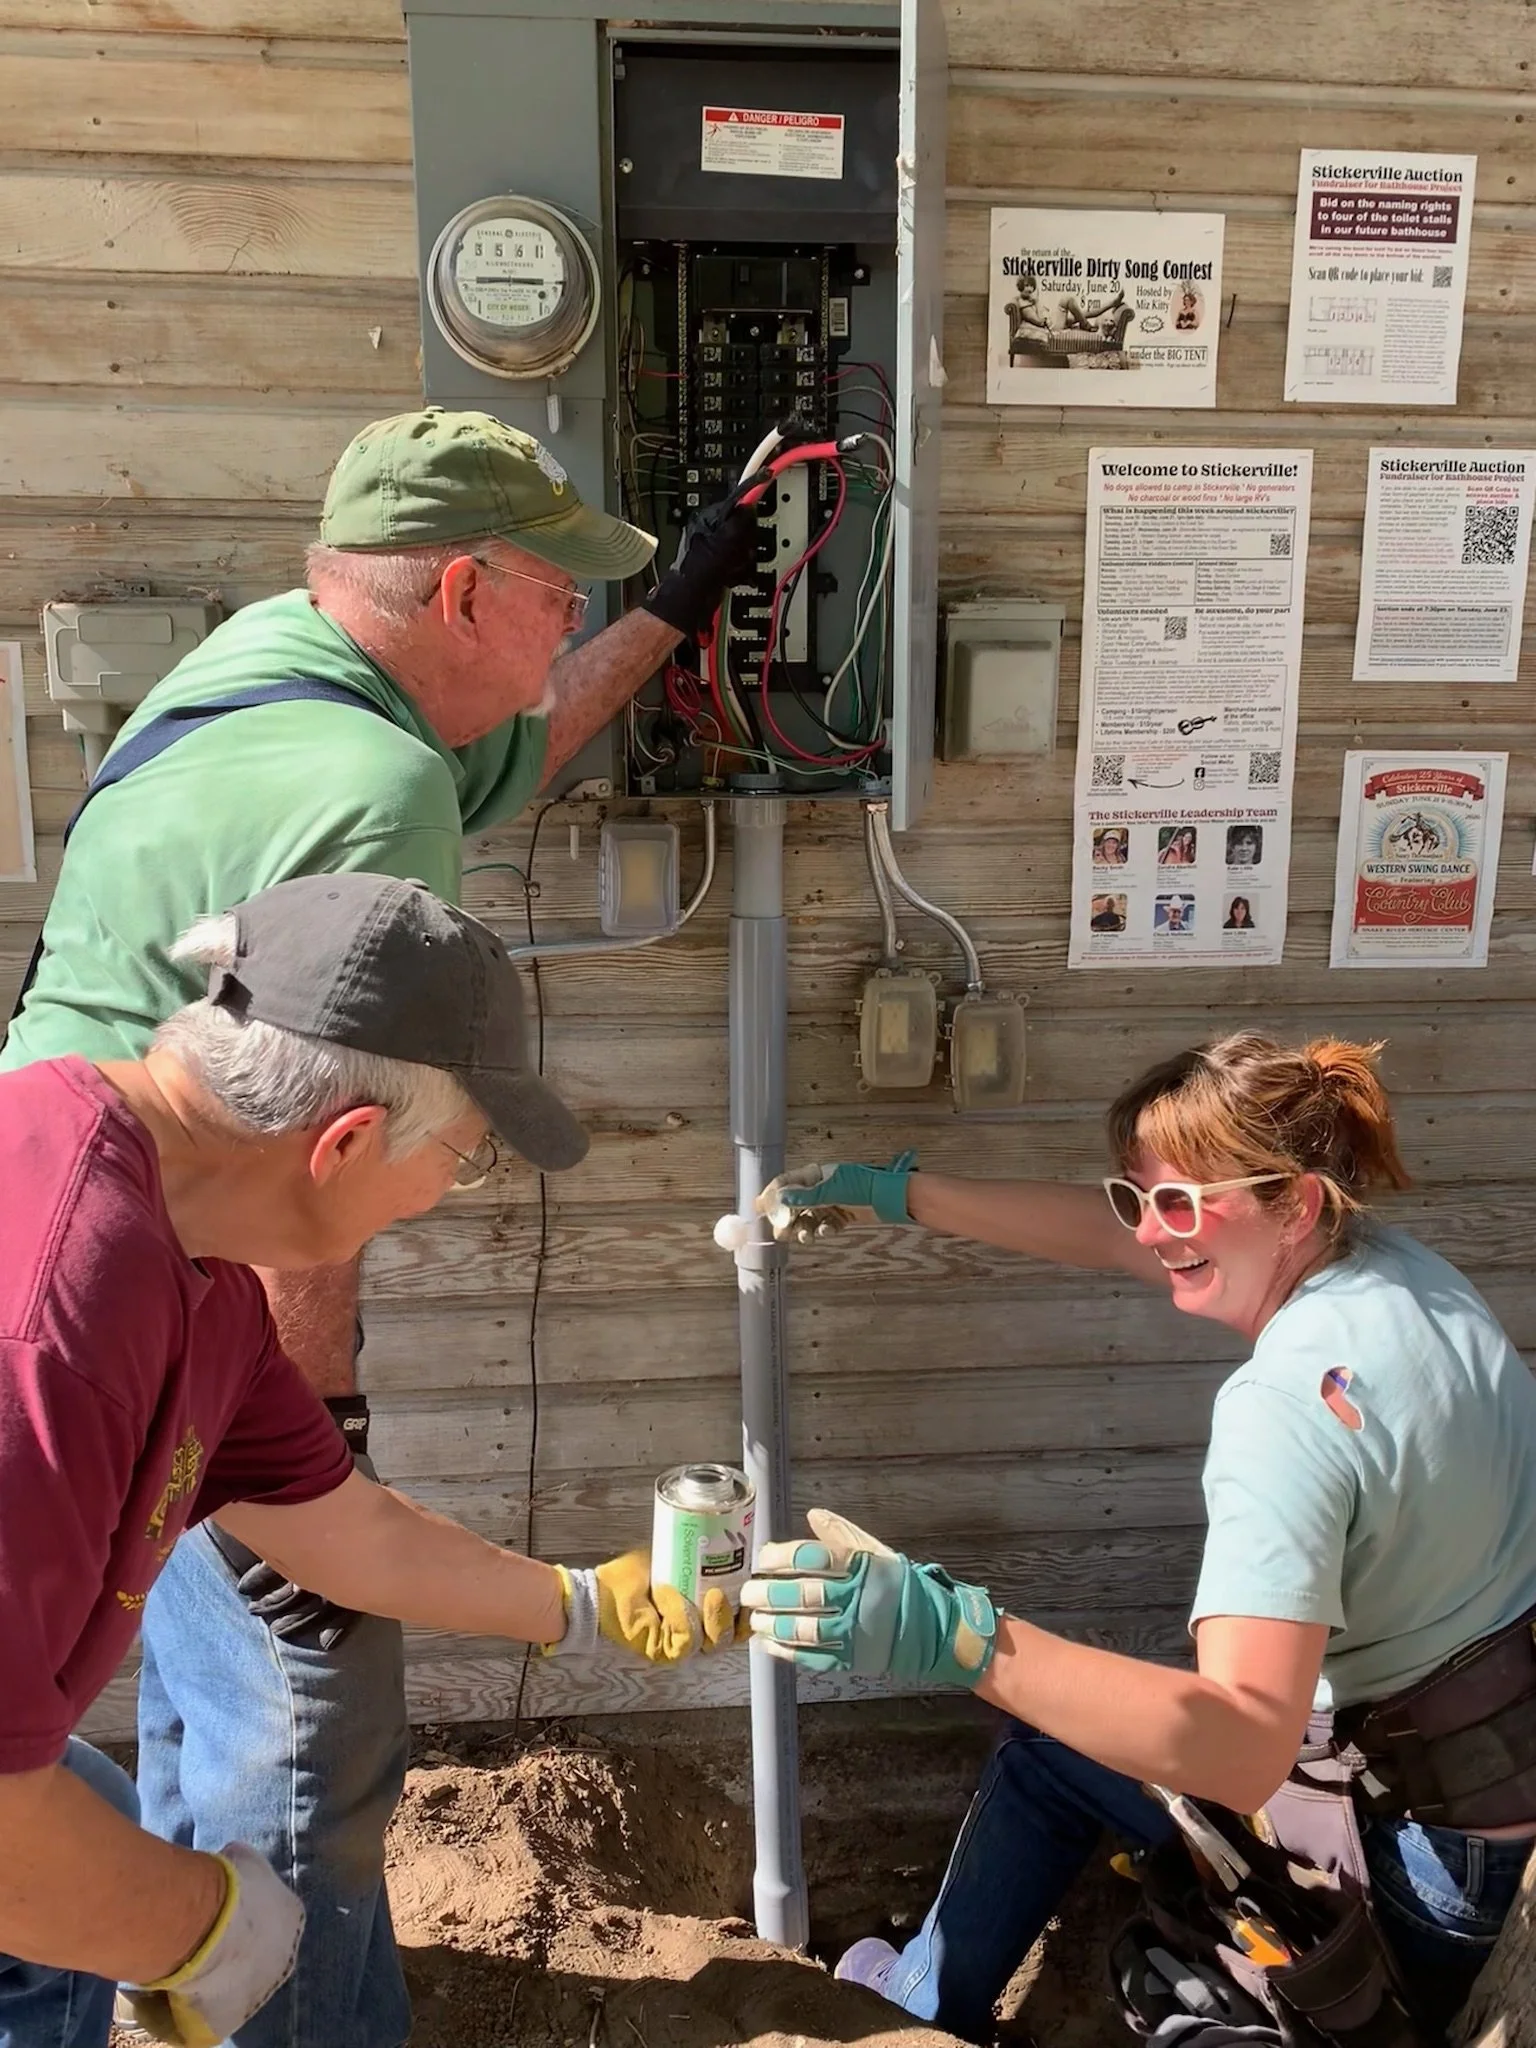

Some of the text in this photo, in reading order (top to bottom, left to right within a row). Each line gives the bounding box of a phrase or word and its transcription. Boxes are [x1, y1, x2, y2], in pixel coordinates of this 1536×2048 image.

[743, 113, 820, 127] DANGER PELIGRO
[1312, 165, 1463, 183] Stickerville Auction
[1320, 198, 1452, 212] Bid on the naming rights
[1318, 212, 1452, 224] to four of the toilet stalls
[1321, 225, 1446, 238] in our future bathhouse
[1053, 248, 1059, 256] of
[1003, 256, 1212, 281] Stickerville Dirty Song Contest
[1308, 266, 1326, 281] Scan
[1328, 267, 1340, 282] QR
[1360, 268, 1368, 282] to
[1370, 268, 1389, 284] place
[1042, 279, 1120, 296] Saturday, June 20
[1136, 285, 1172, 300] Hosted by
[1080, 296, 1086, 308] 8
[1152, 300, 1169, 313] Kitty
[1130, 348, 1206, 360] under the BIG TENT
[1102, 464, 1298, 476] Welcome to Stickerville!
[1380, 459, 1525, 474] Stickerville Auction
[1446, 474, 1493, 482] Bathhouse
[1494, 475, 1525, 483] Project
[1116, 484, 1134, 492] dogs
[1396, 784, 1453, 794] Stickerville
[1088, 808, 1278, 820] The Stickerville Leadership Team
[1367, 864, 1471, 873] WESTERN SWING DANCE
[1365, 887, 1430, 914] Country
[1430, 887, 1472, 914] Club
[684, 1529, 695, 1565] Solvent
